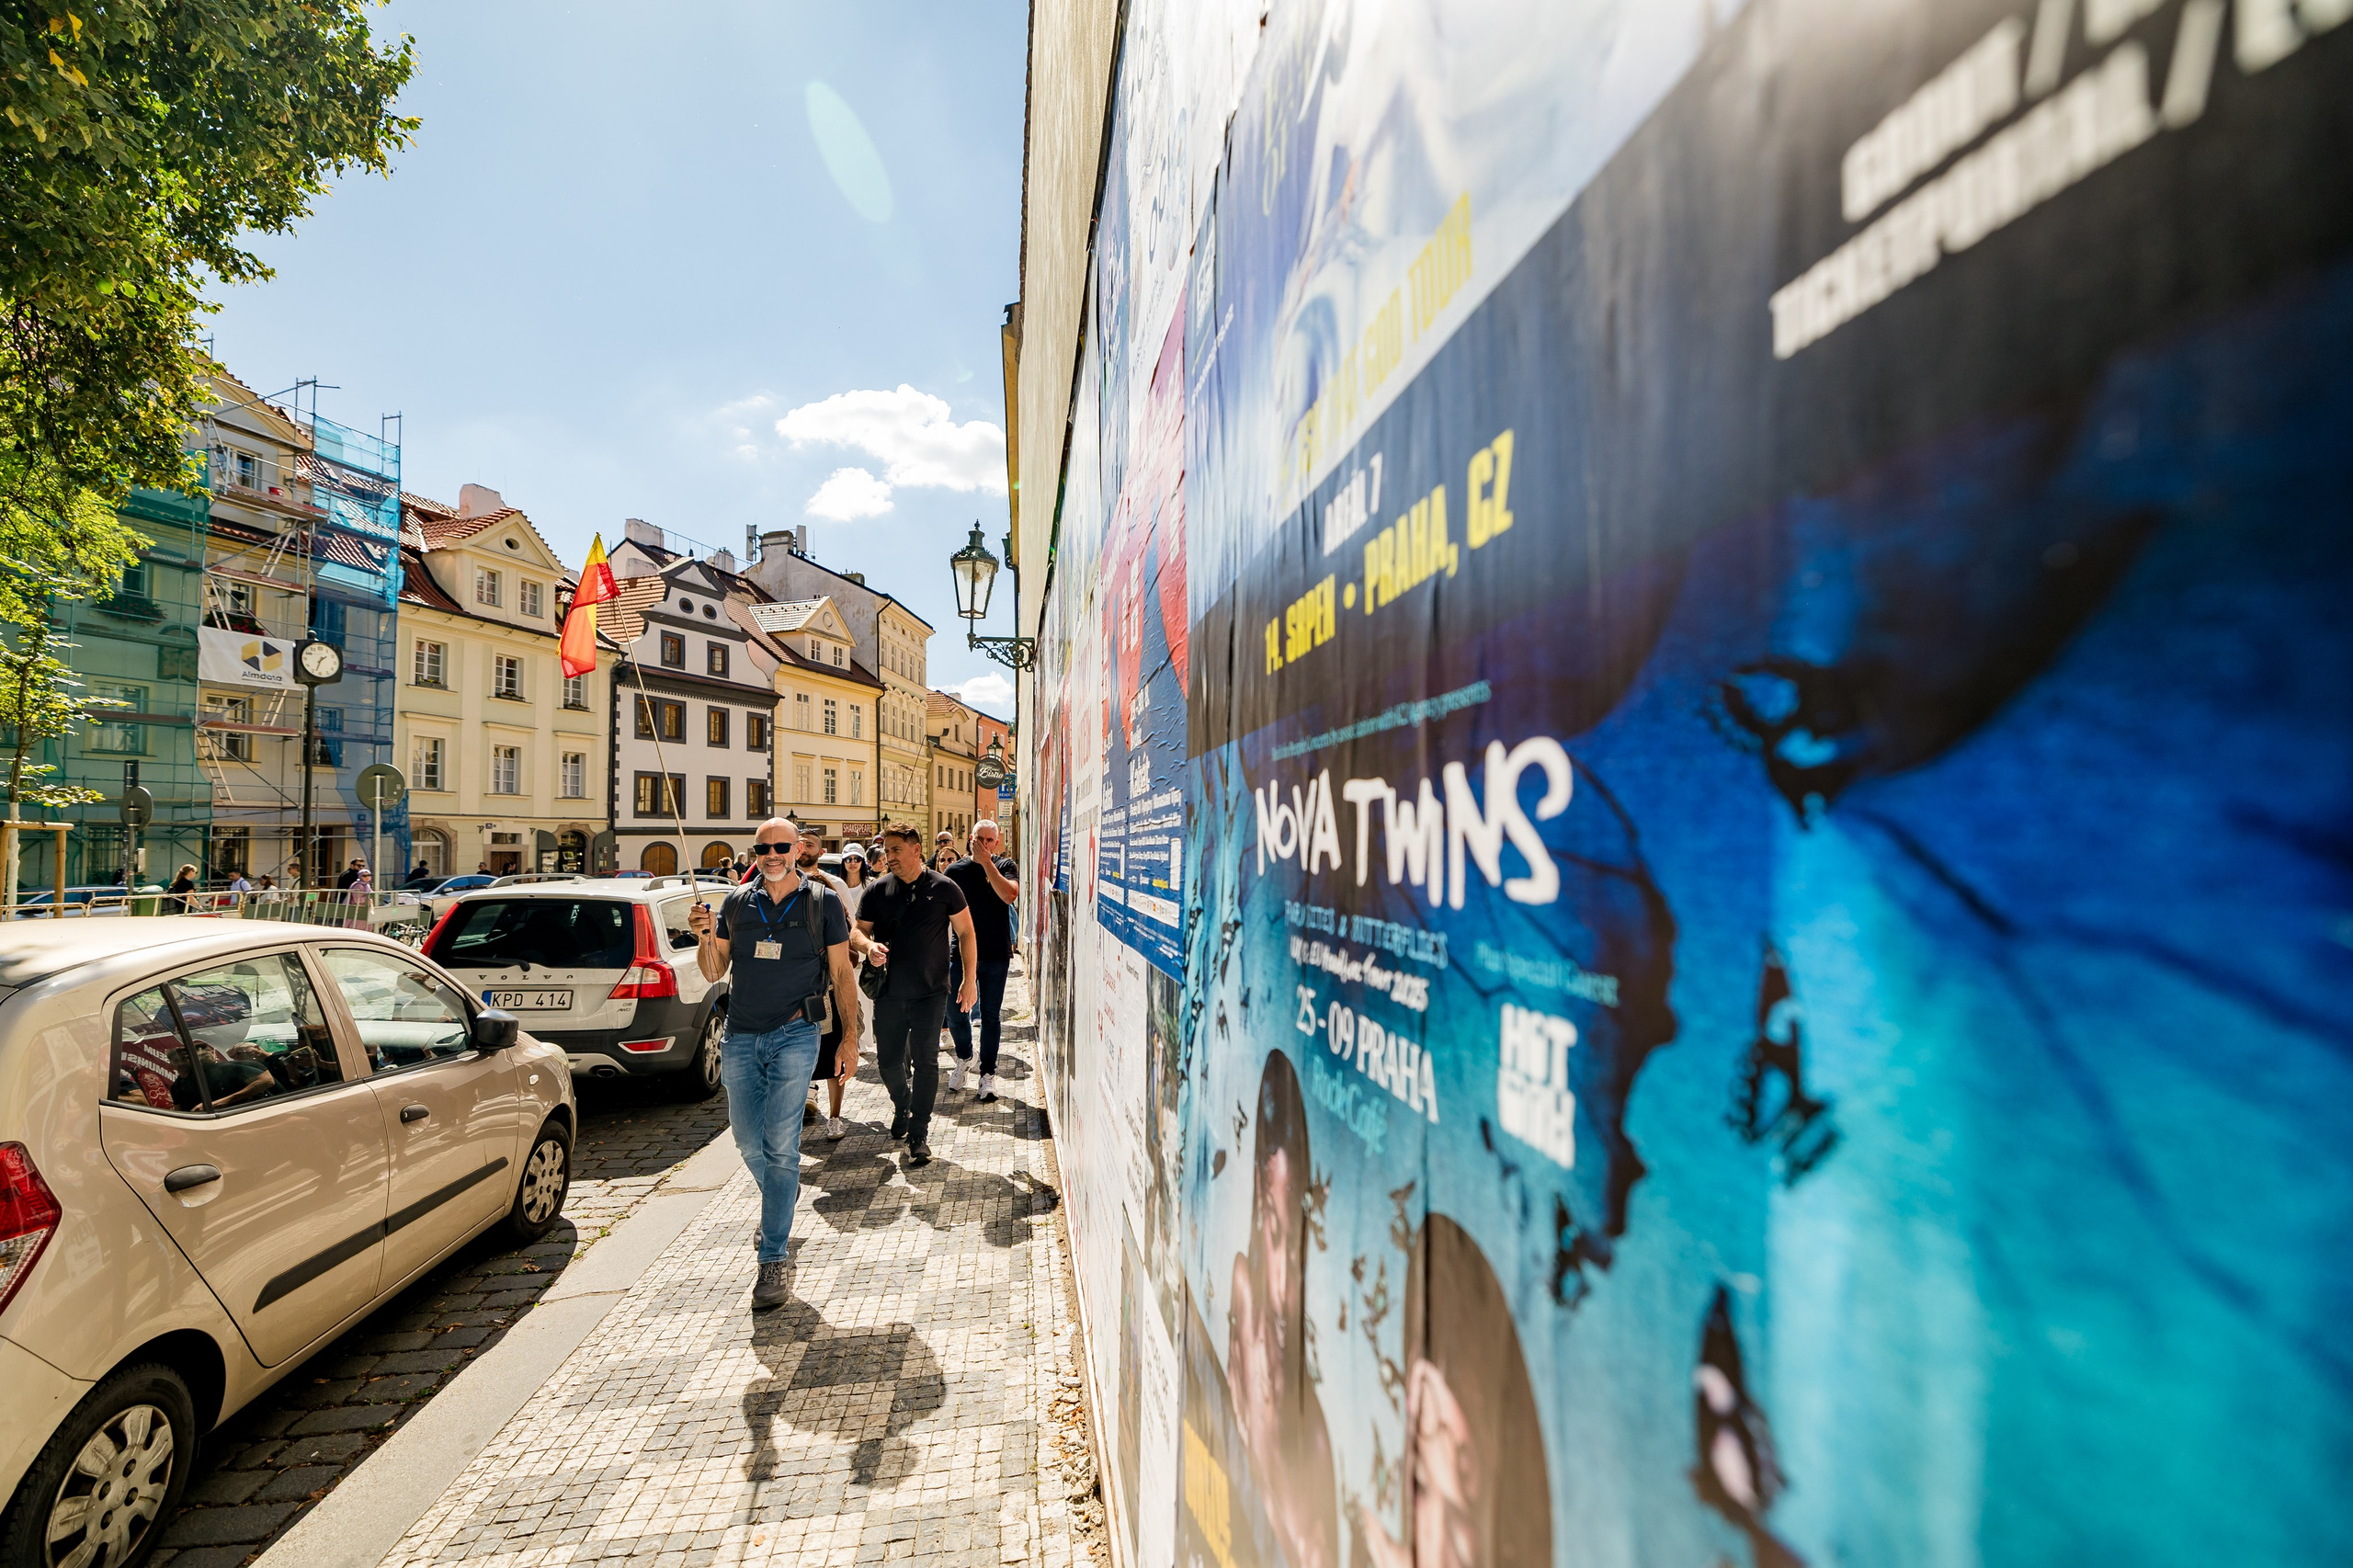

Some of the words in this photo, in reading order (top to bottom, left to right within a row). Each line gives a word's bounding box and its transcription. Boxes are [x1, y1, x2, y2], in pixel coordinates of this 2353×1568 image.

[1408, 190, 1472, 344] TOUR
[1286, 573, 1336, 664] SRPEN
[1364, 483, 1459, 616] PRAHA,
[1467, 427, 1515, 551] CZ
[1343, 736, 1573, 910] TWINS
[492, 993, 523, 1007] KPD
[535, 993, 567, 1007] 414
[1356, 1013, 1440, 1125] PRAHA
